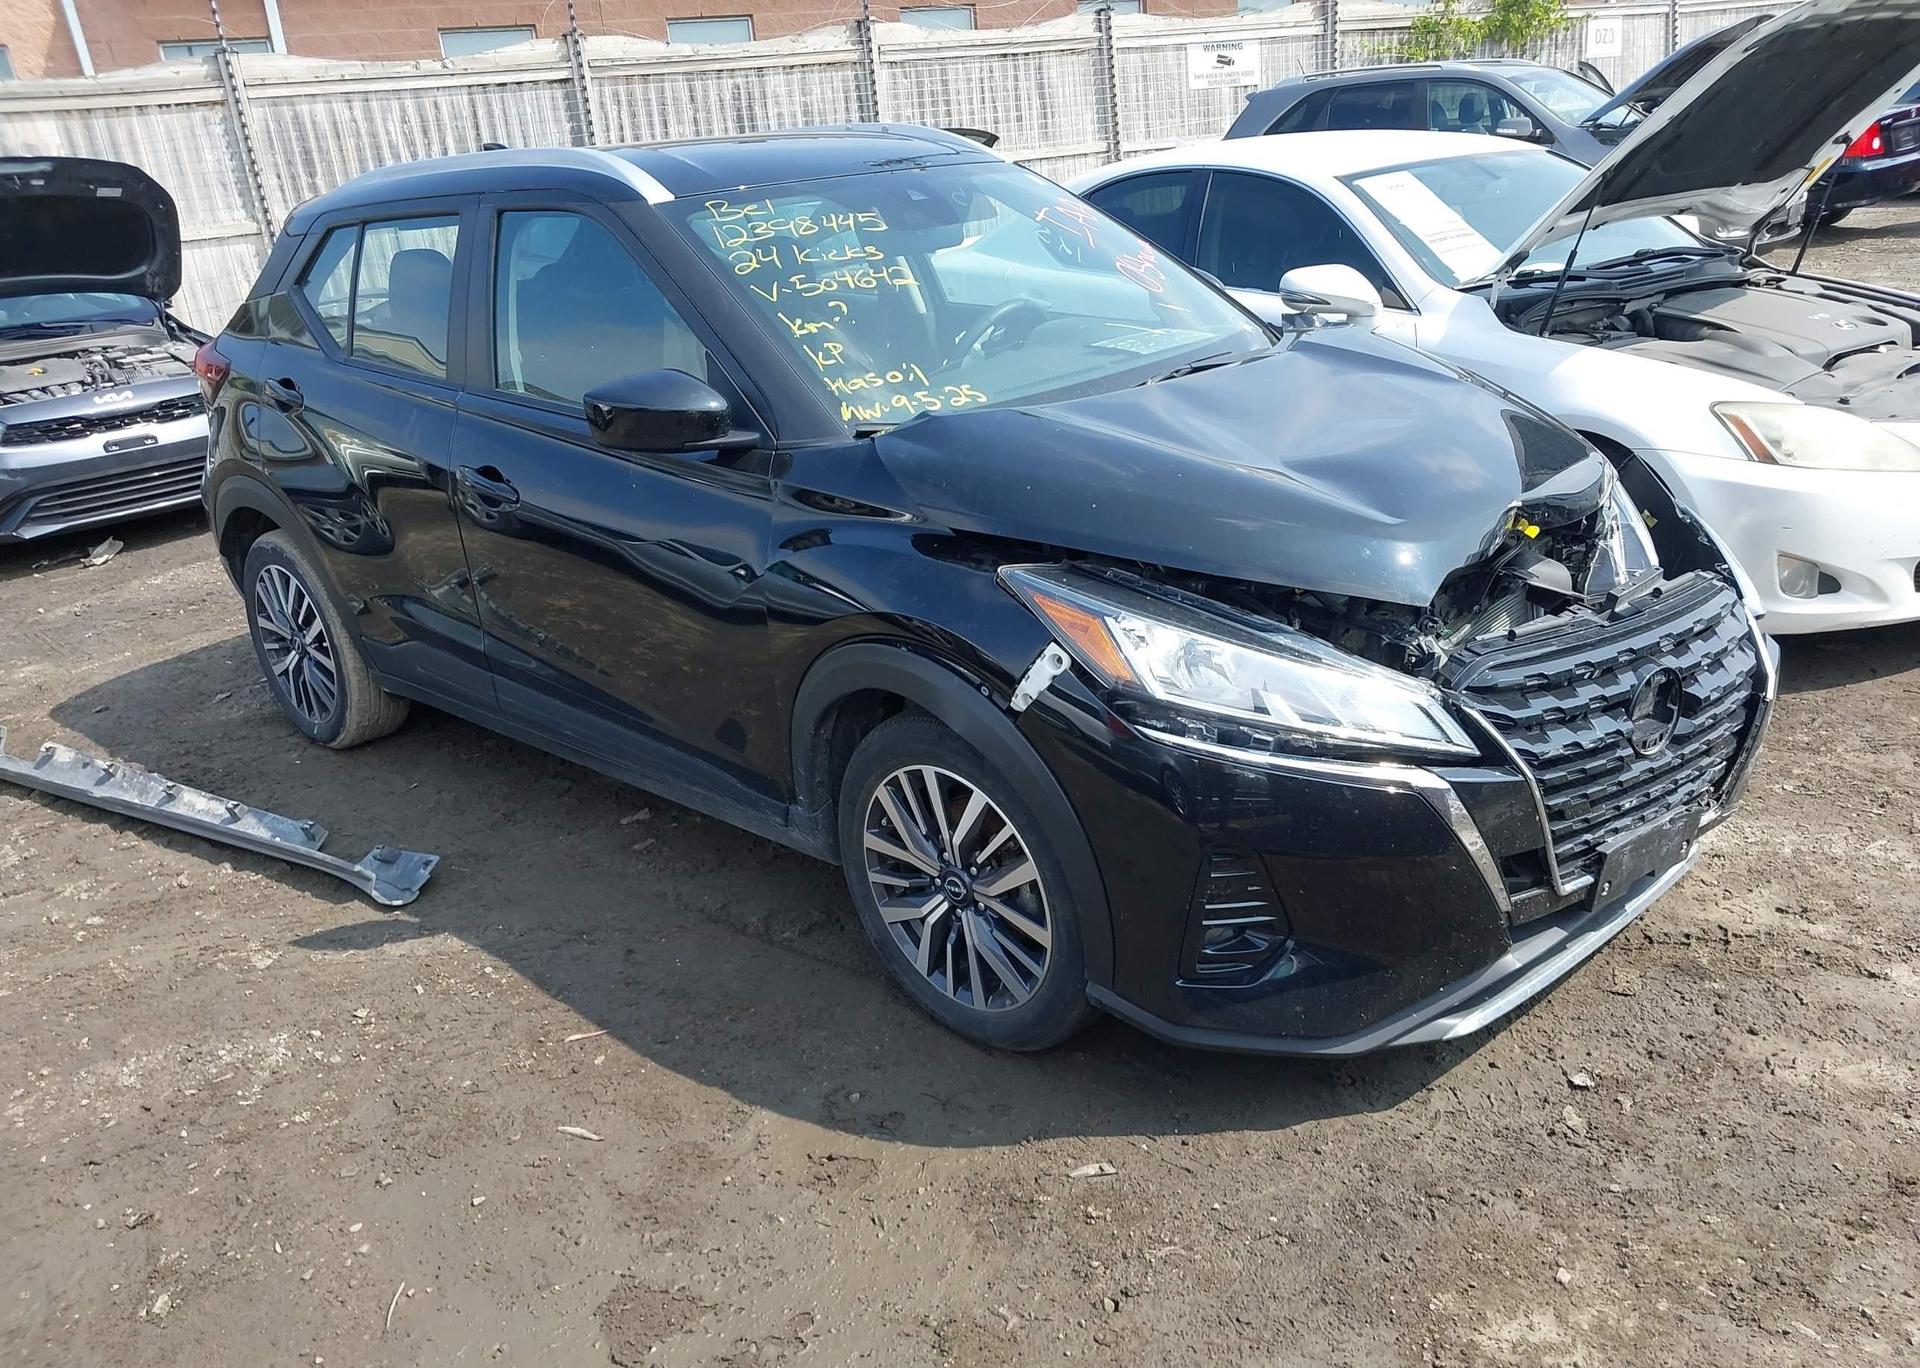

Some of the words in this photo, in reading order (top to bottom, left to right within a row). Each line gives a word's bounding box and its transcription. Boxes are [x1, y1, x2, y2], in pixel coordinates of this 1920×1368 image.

[1202, 42, 1244, 52] WARNING
[1241, 69, 1255, 77] VIDEO
[728, 245, 783, 276] 24
